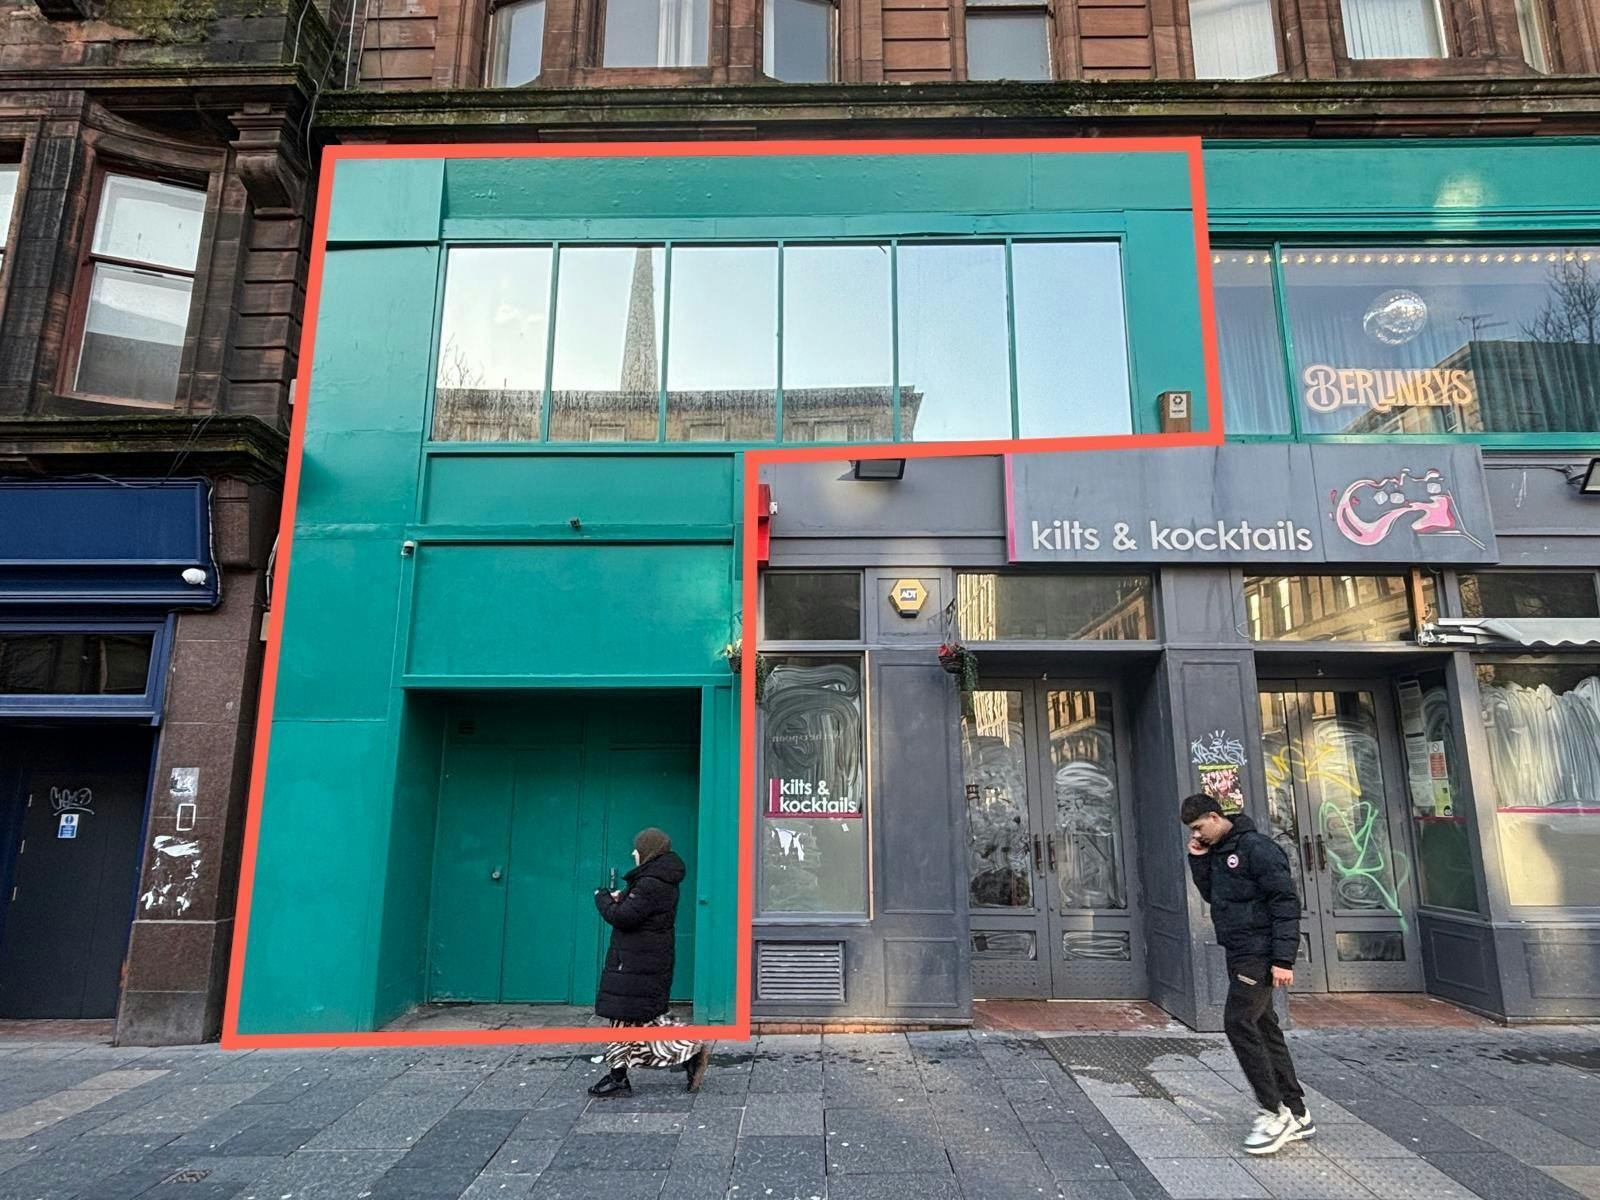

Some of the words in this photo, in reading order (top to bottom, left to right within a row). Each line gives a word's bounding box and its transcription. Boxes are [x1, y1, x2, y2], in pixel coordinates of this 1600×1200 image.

[1304, 364, 1473, 413] BERLINKYS
[1031, 519, 1100, 550] kilts
[1112, 523, 1137, 550] &
[1150, 519, 1313, 552] kocktails
[780, 779, 812, 795] kilts
[817, 780, 831, 795] &
[779, 796, 858, 813] kocktails
